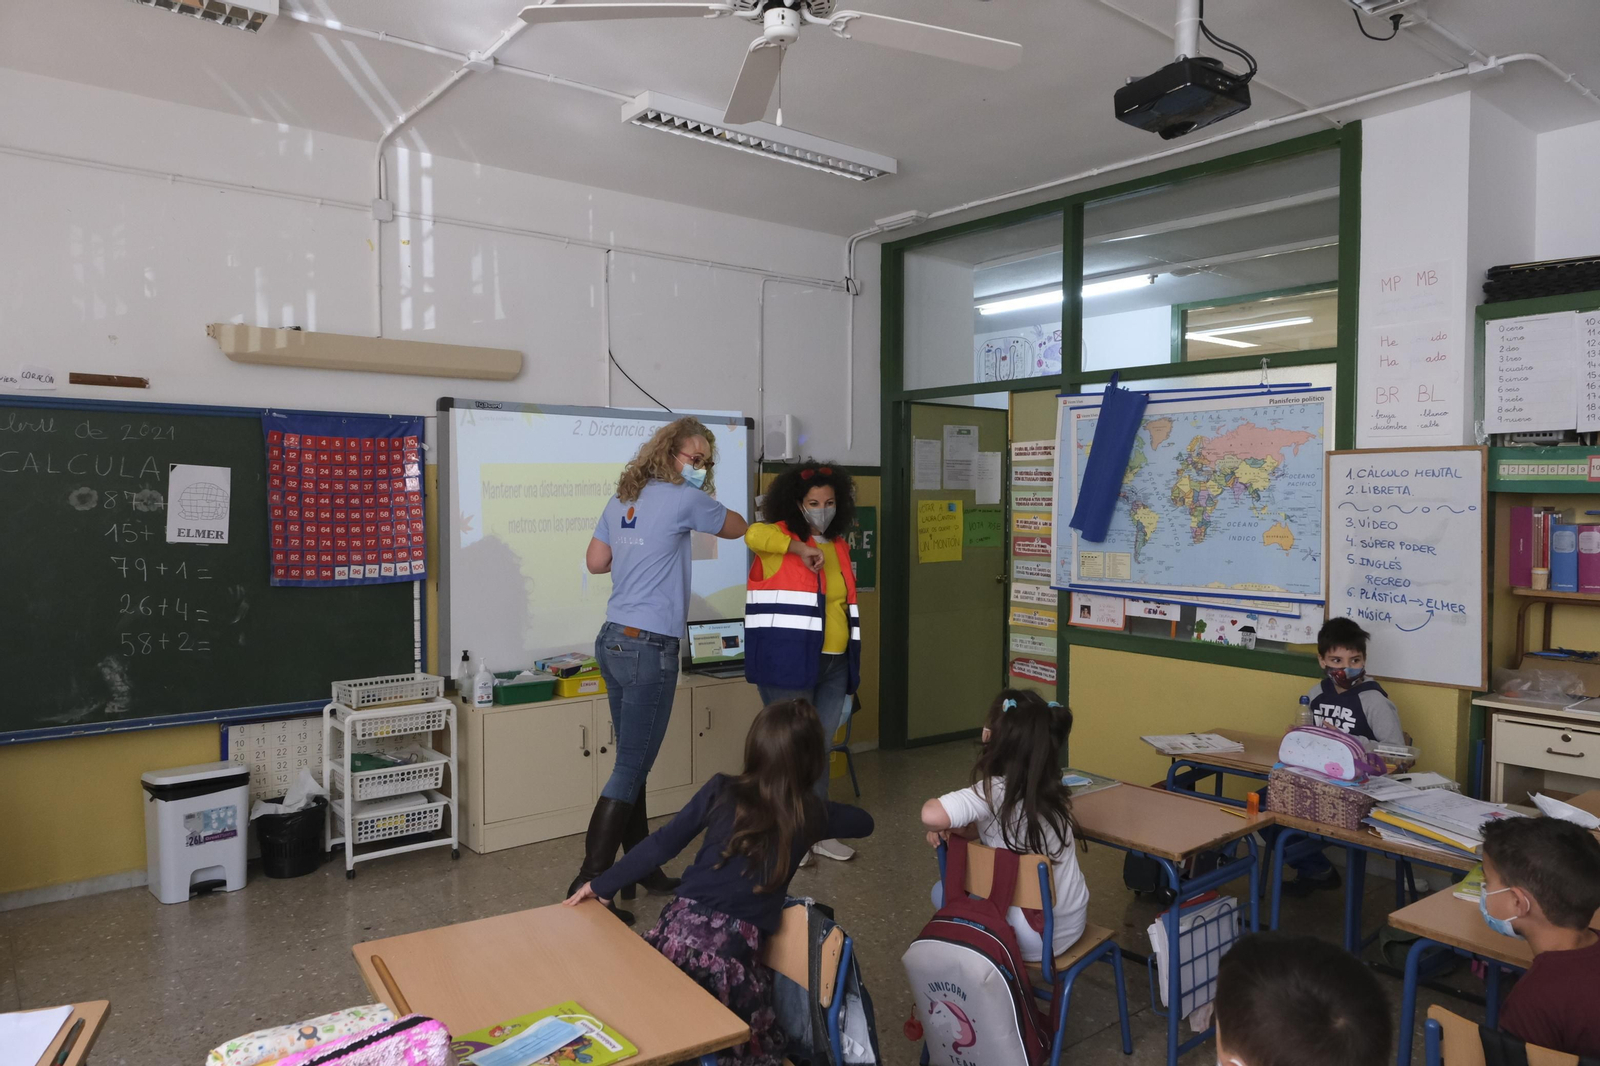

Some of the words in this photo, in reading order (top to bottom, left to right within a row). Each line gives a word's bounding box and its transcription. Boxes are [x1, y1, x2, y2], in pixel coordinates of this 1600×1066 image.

[1381, 275, 1401, 292] MP
[1416, 270, 1438, 286] MB
[1380, 336, 1398, 347] He
[1380, 355, 1399, 367] Ha
[1426, 351, 1446, 362] ado
[1376, 386, 1399, 404] BR
[1418, 384, 1445, 402] BL
[75, 420, 108, 439] de
[121, 424, 175, 441] 2021
[588, 420, 645, 436] Distancia
[0, 451, 160, 481] CALCULA
[1415, 467, 1462, 479] MENTAL
[482, 481, 521, 500] Mantener
[524, 485, 537, 499] una
[539, 481, 574, 498] distancia
[603, 482, 612, 496] de
[508, 518, 537, 533] metros
[538, 520, 551, 532] con
[553, 518, 564, 531] las
[565, 516, 598, 532] personas
[177, 528, 225, 540] ELMER
[1400, 541, 1436, 556] PODER
[1365, 574, 1411, 588] RECREO
[1426, 598, 1466, 614] ELMER
[1314, 704, 1356, 723] STAR
[1314, 715, 1355, 734] WARS
[928, 981, 967, 1001] UNICORN
[949, 1055, 976, 1066] TEAM
